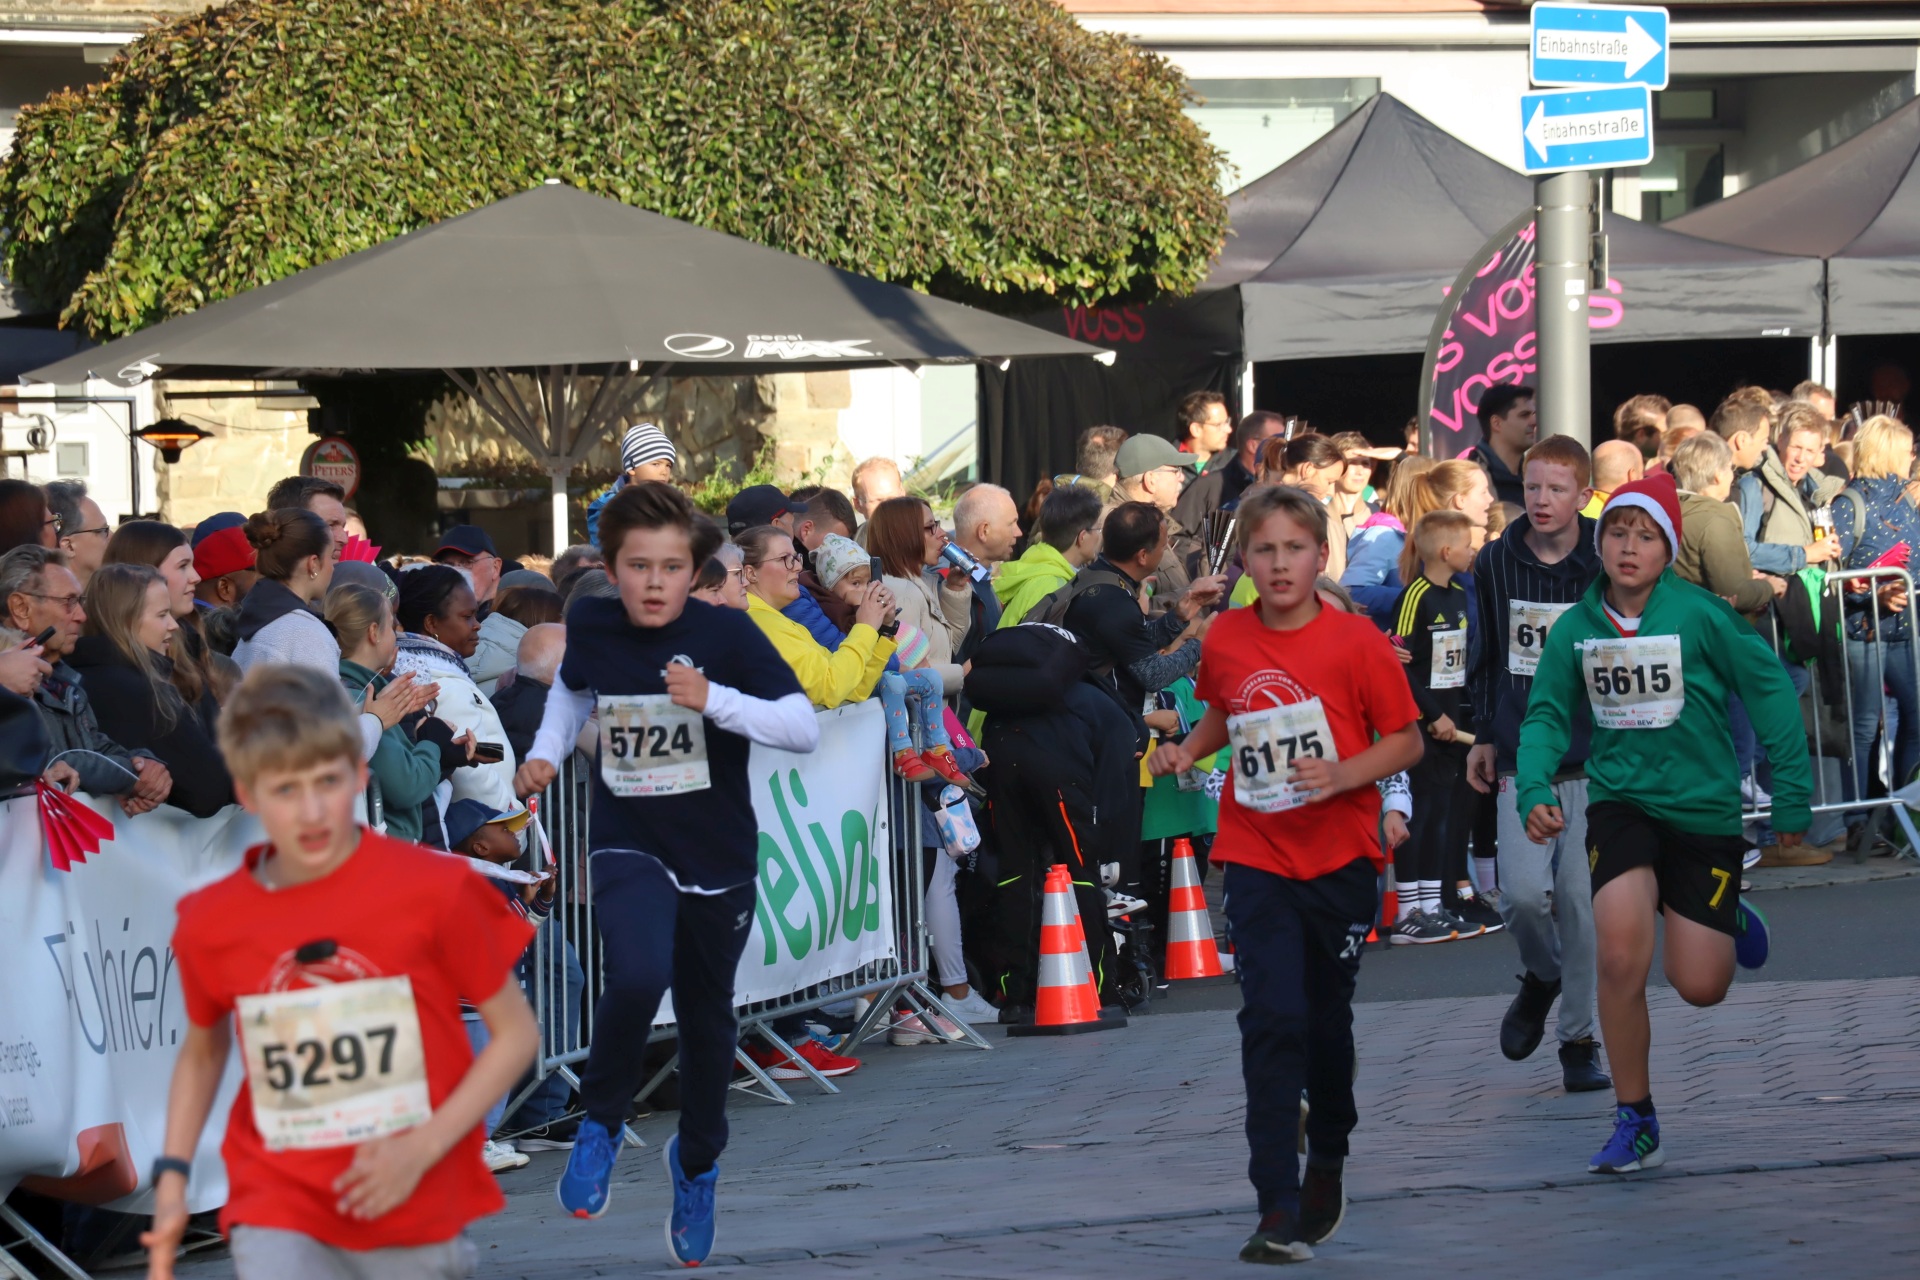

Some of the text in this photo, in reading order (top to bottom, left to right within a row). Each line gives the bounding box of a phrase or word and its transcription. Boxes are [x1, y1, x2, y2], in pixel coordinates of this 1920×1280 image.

[1540, 36, 1628, 55] Einbahnstraße
[1543, 116, 1639, 139] Einbahnstraße
[1063, 305, 1145, 343] VOSS
[314, 464, 354, 477] PETERS
[1517, 623, 1547, 649] 61
[1592, 663, 1671, 696] 5615
[610, 723, 694, 758] 5724
[1239, 730, 1324, 778] 6175
[967, 851, 978, 873] Joie
[1709, 867, 1732, 910] 7
[262, 1023, 398, 1091] 5297
